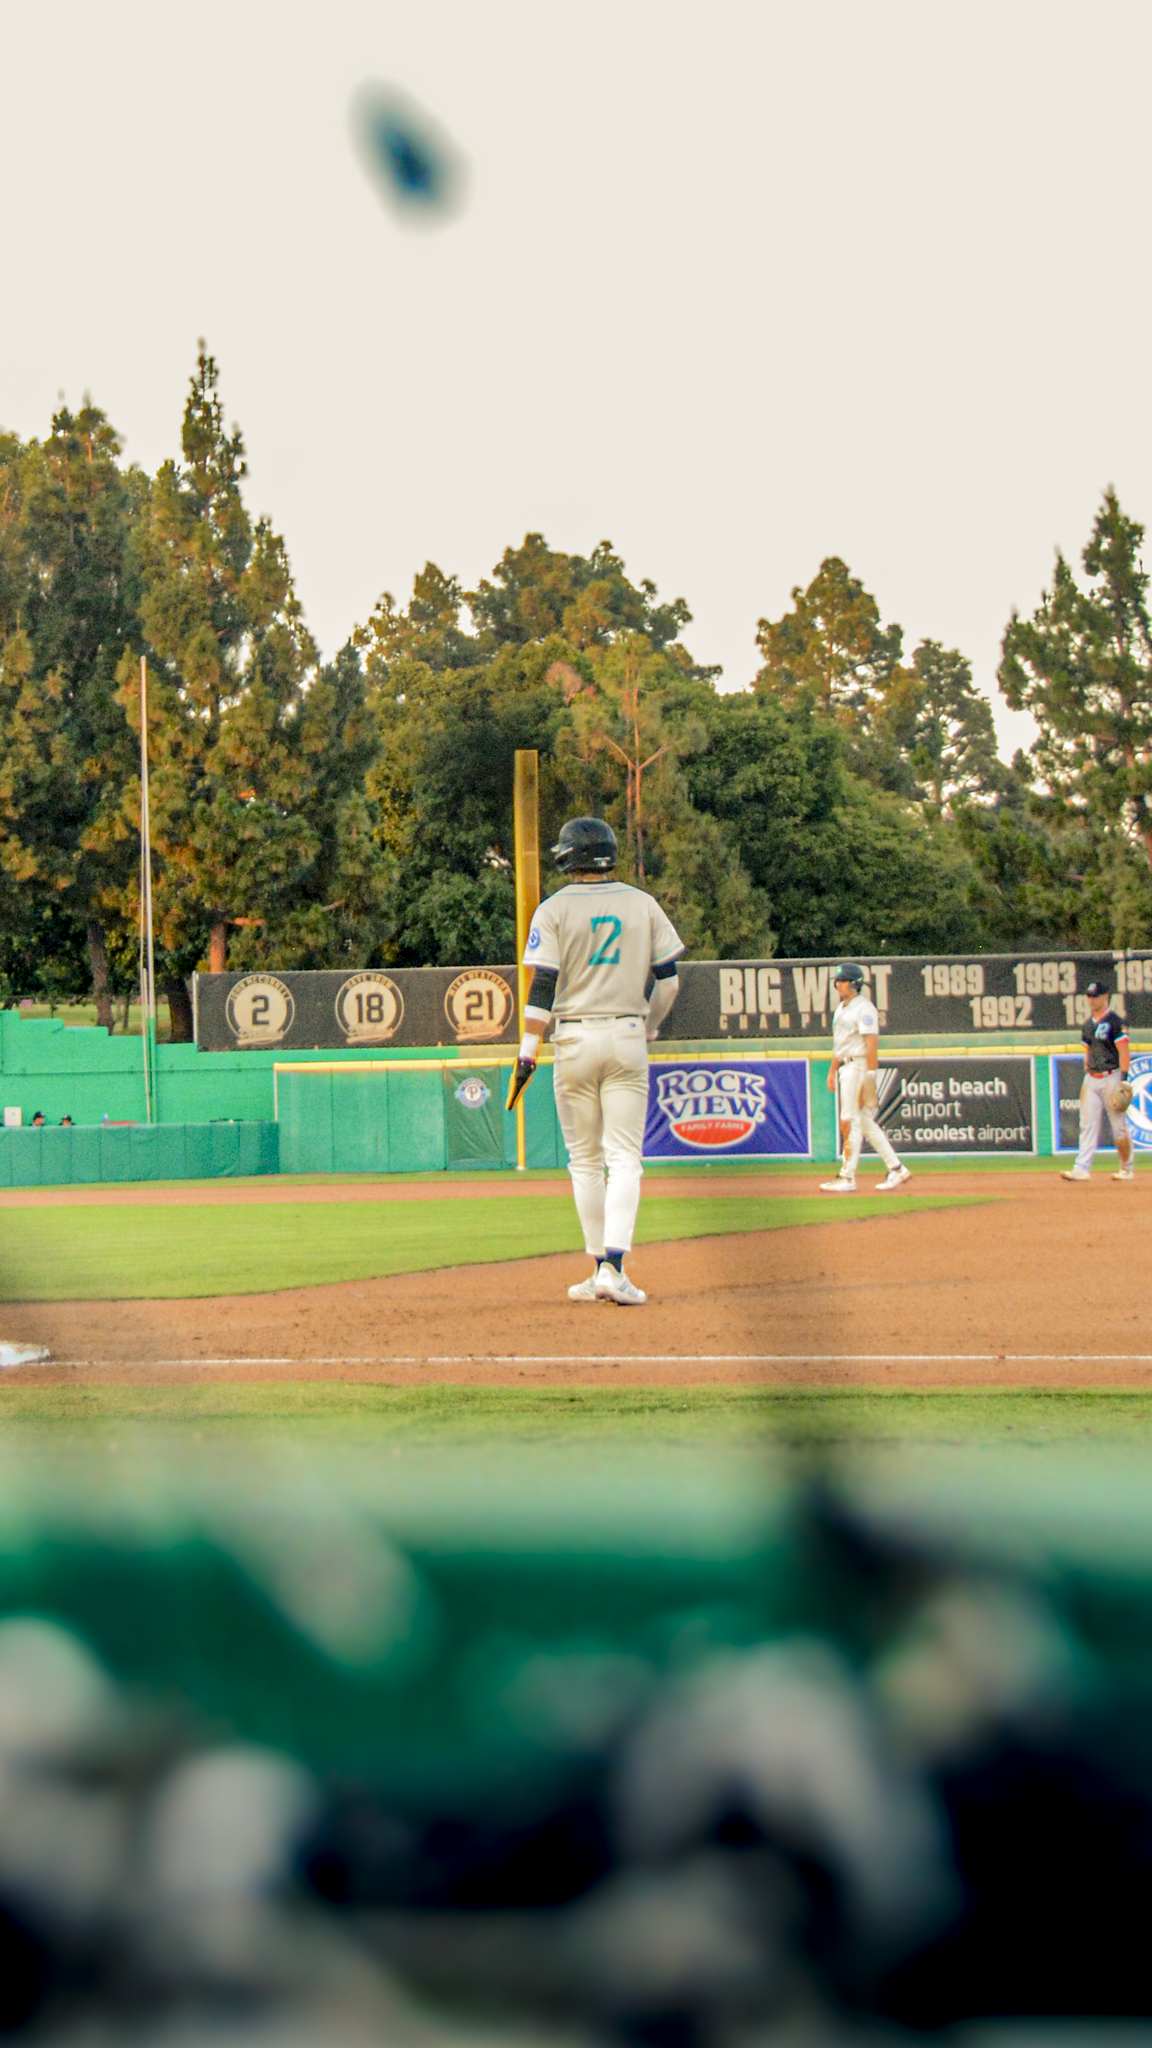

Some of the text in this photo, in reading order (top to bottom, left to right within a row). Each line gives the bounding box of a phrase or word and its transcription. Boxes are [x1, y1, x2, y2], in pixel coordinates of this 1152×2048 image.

[589, 915, 622, 966] 2
[719, 968, 782, 1014] BIG
[921, 964, 984, 996] 1989
[1013, 961, 1077, 994] 1993
[252, 994, 269, 1025] 2
[356, 993, 384, 1023] 18
[465, 990, 494, 1021] 21
[970, 995, 1033, 1028] 1992
[1062, 993, 1127, 1026] 194
[719, 1012, 887, 1031] CHAMPIS
[661, 1073, 762, 1100] ROCK
[901, 1076, 1007, 1099] long beach
[663, 1095, 762, 1119] VIEW
[901, 1100, 961, 1121] airport
[681, 1121, 744, 1131] FAMILY FARMS
[915, 1124, 974, 1141] coolest
[978, 1124, 1026, 1143] airport
